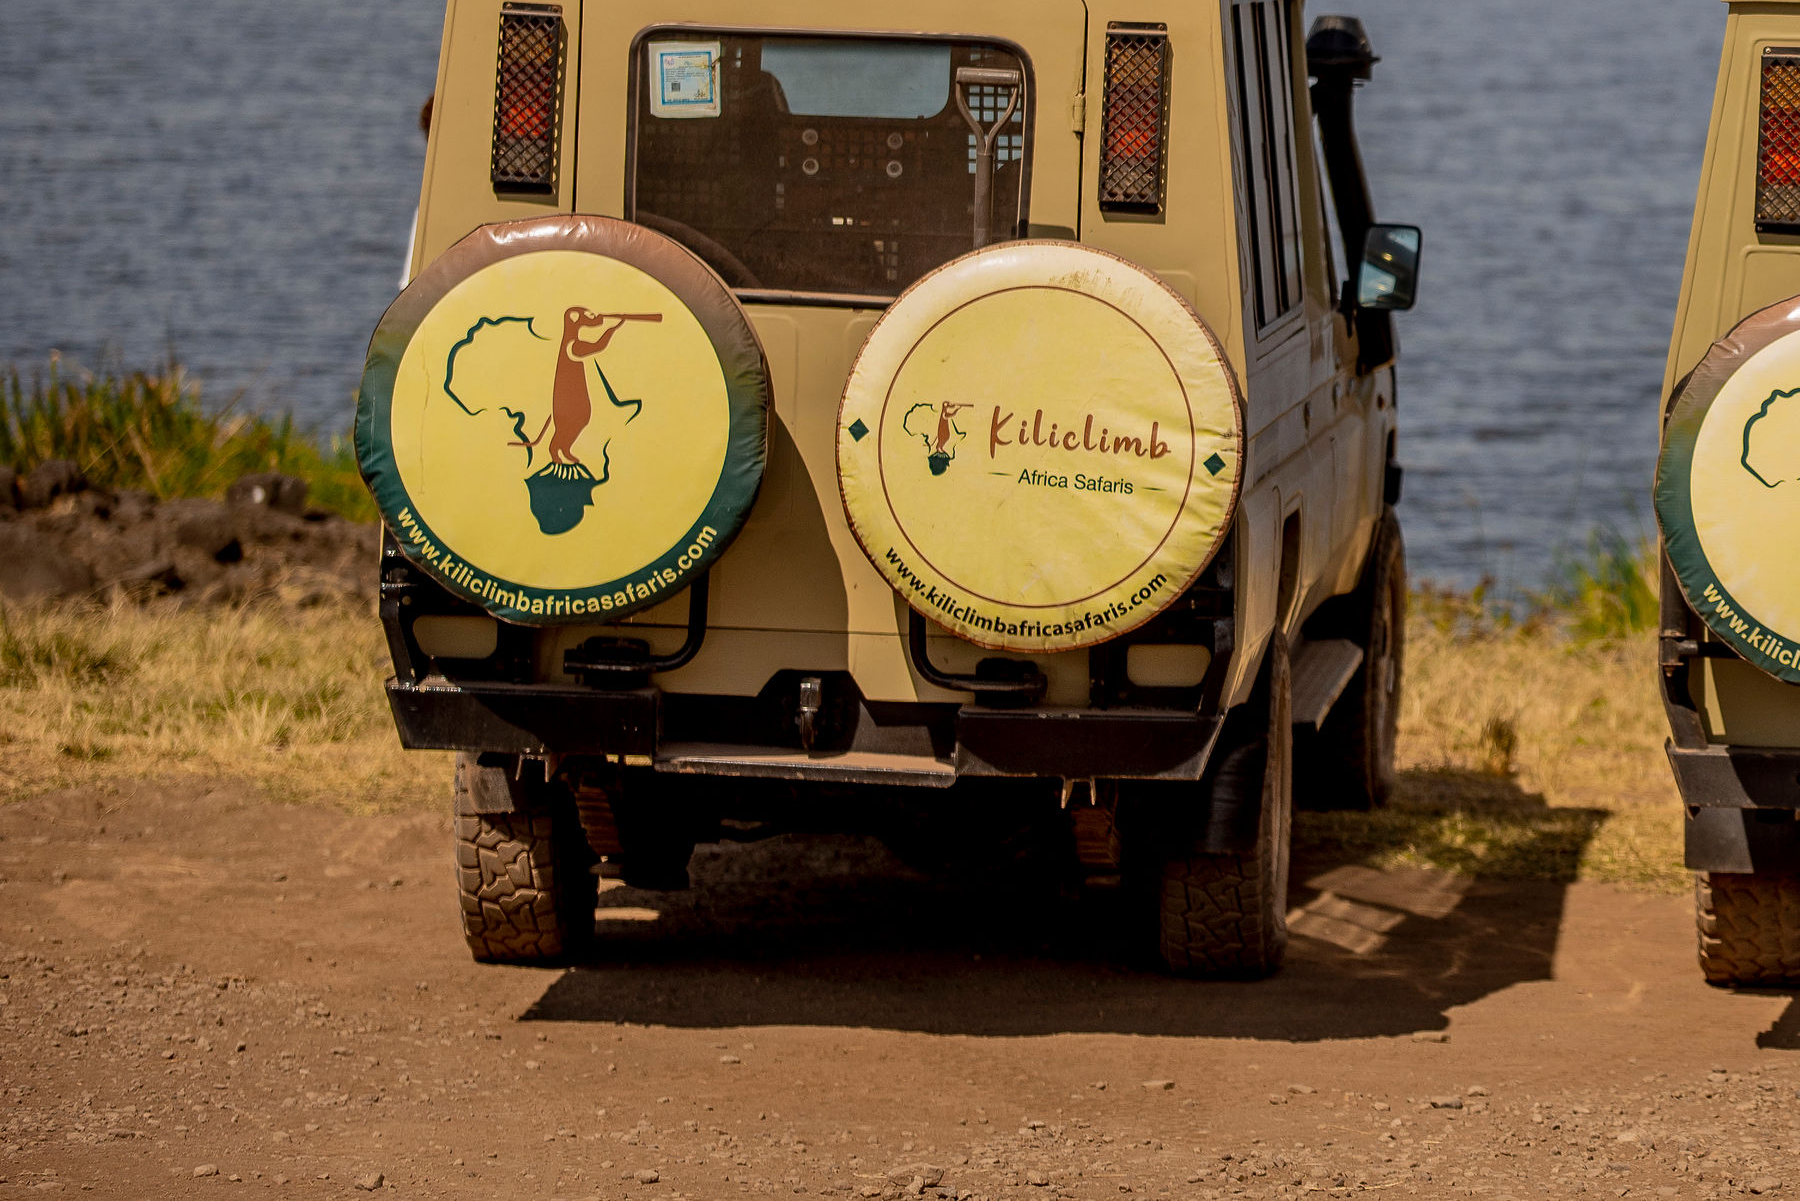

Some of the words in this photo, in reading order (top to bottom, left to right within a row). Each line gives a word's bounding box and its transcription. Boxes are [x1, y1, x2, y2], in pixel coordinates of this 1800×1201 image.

[988, 405, 1172, 459] Kiliclimb
[1017, 467, 1069, 489] Africa
[1073, 473, 1134, 495] Safaris
[397, 506, 718, 616] www.kiliclimbafricasafaris.com
[885, 546, 1168, 638] www.kiliclimbafricasafaris.com
